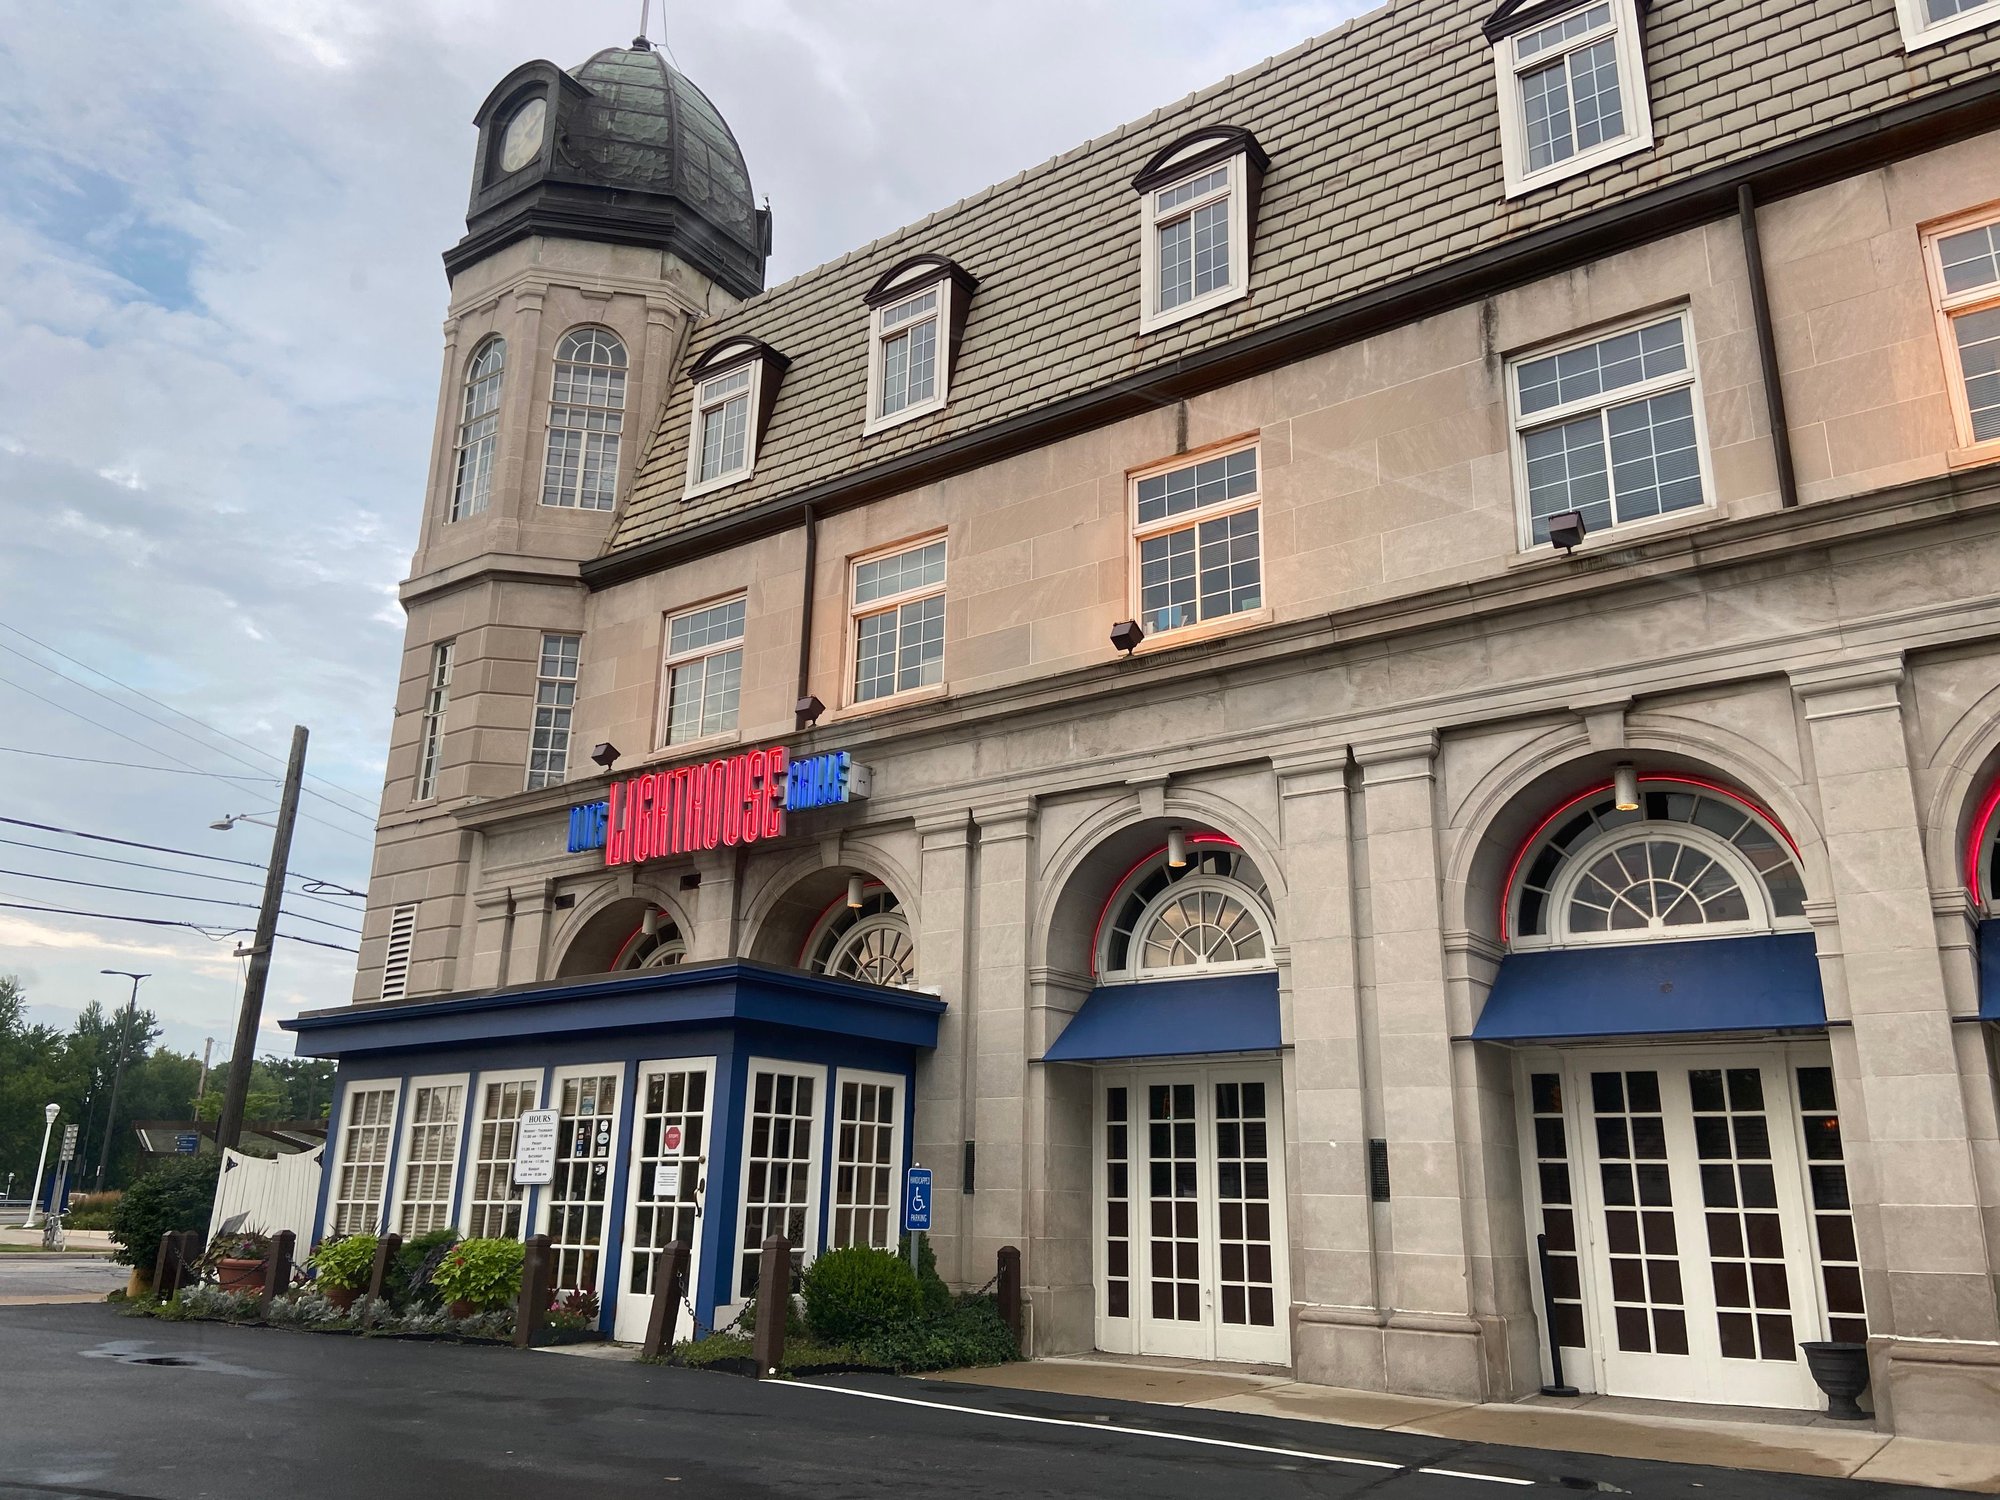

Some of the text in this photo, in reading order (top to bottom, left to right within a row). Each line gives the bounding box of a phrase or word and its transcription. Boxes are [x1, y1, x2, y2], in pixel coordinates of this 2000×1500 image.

[605, 745, 790, 866] LIGHTHOUSE
[528, 1114, 551, 1123] HOURS
[910, 1176, 930, 1185] HANDICAPPED
[910, 1214, 927, 1222] PARKING
